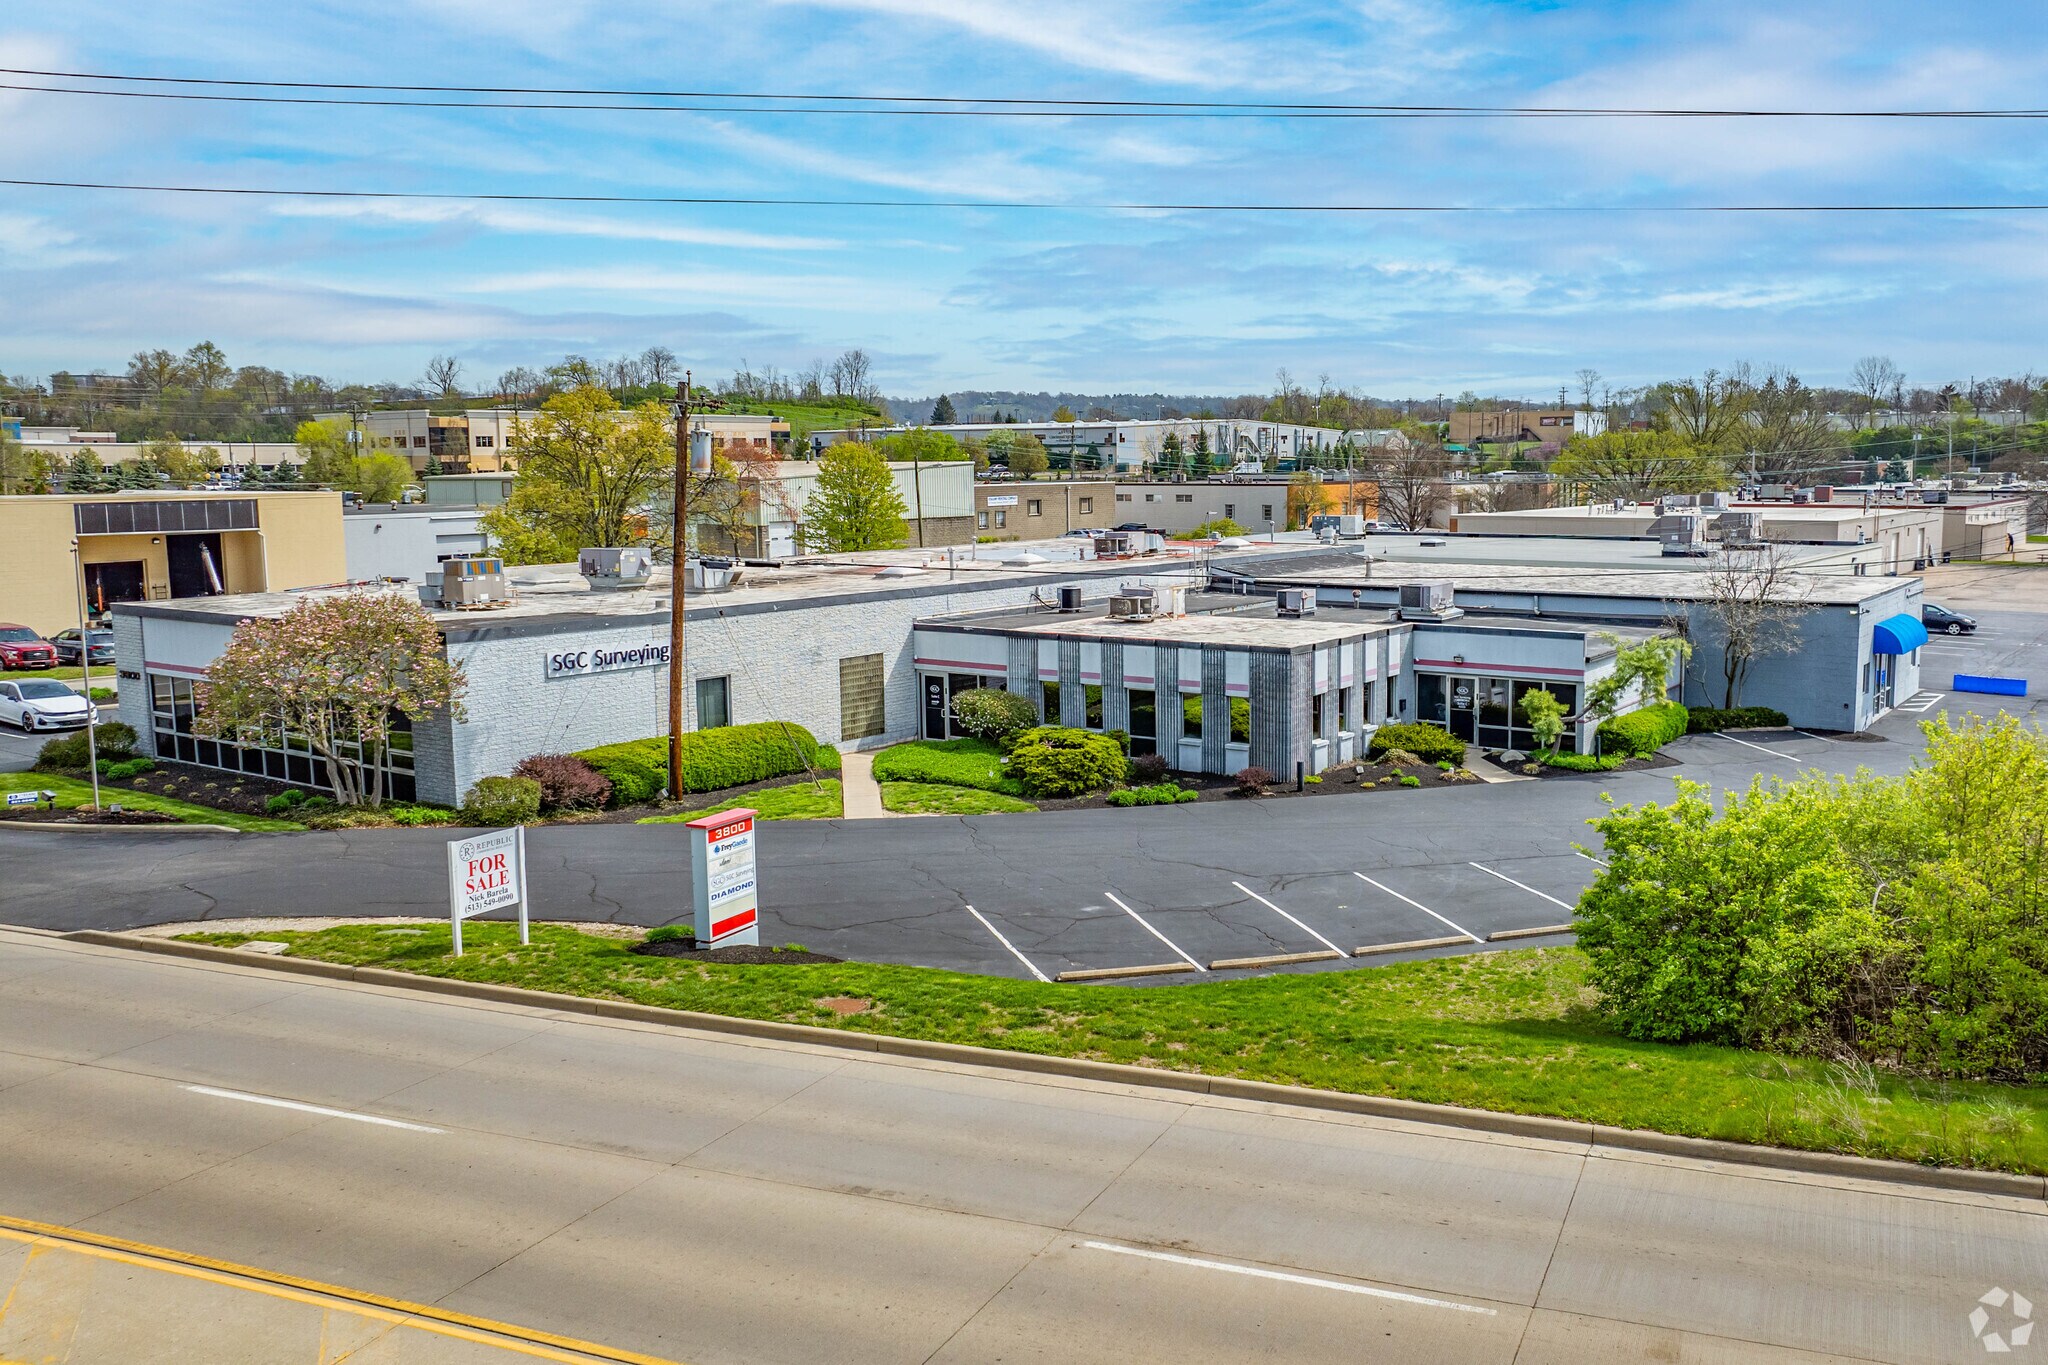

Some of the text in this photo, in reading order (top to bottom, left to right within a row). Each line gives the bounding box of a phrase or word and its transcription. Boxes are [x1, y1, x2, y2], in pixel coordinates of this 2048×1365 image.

[552, 644, 670, 671] SGC Surveying
[715, 821, 745, 839] 3800
[476, 836, 513, 850] REPUBLIC
[468, 853, 506, 877] FOR
[466, 869, 510, 895] SALE
[711, 881, 754, 901] DIAMOND
[465, 893, 514, 914] (513) 549-0090
[469, 887, 509, 903] Nick Barela
